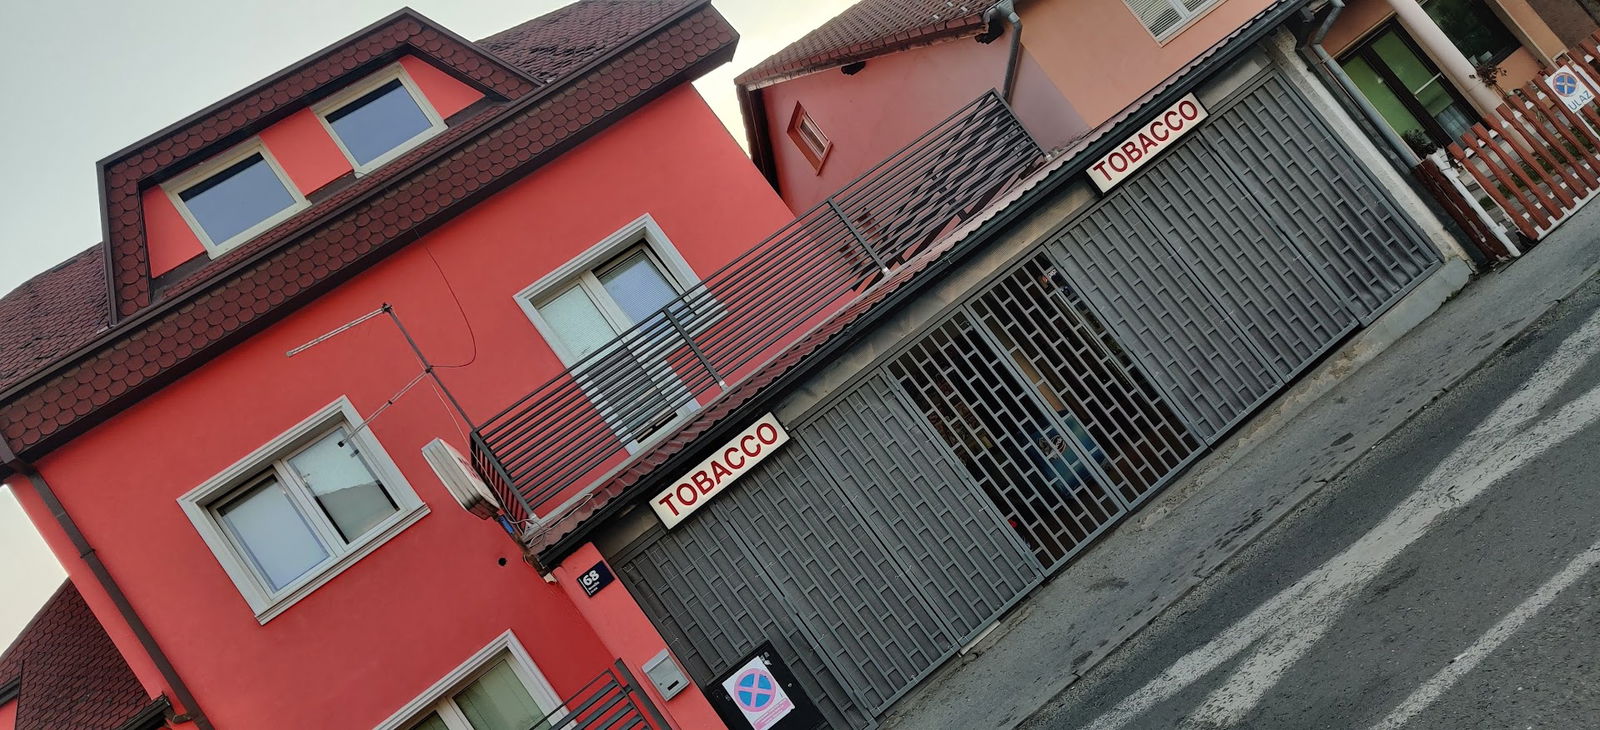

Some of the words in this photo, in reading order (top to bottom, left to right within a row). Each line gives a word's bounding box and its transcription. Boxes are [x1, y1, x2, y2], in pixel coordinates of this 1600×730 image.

[1568, 91, 1592, 110] ULAZ
[1093, 100, 1198, 181] TOBACCO
[658, 422, 778, 517] TOBACCO
[582, 570, 600, 586] 68
